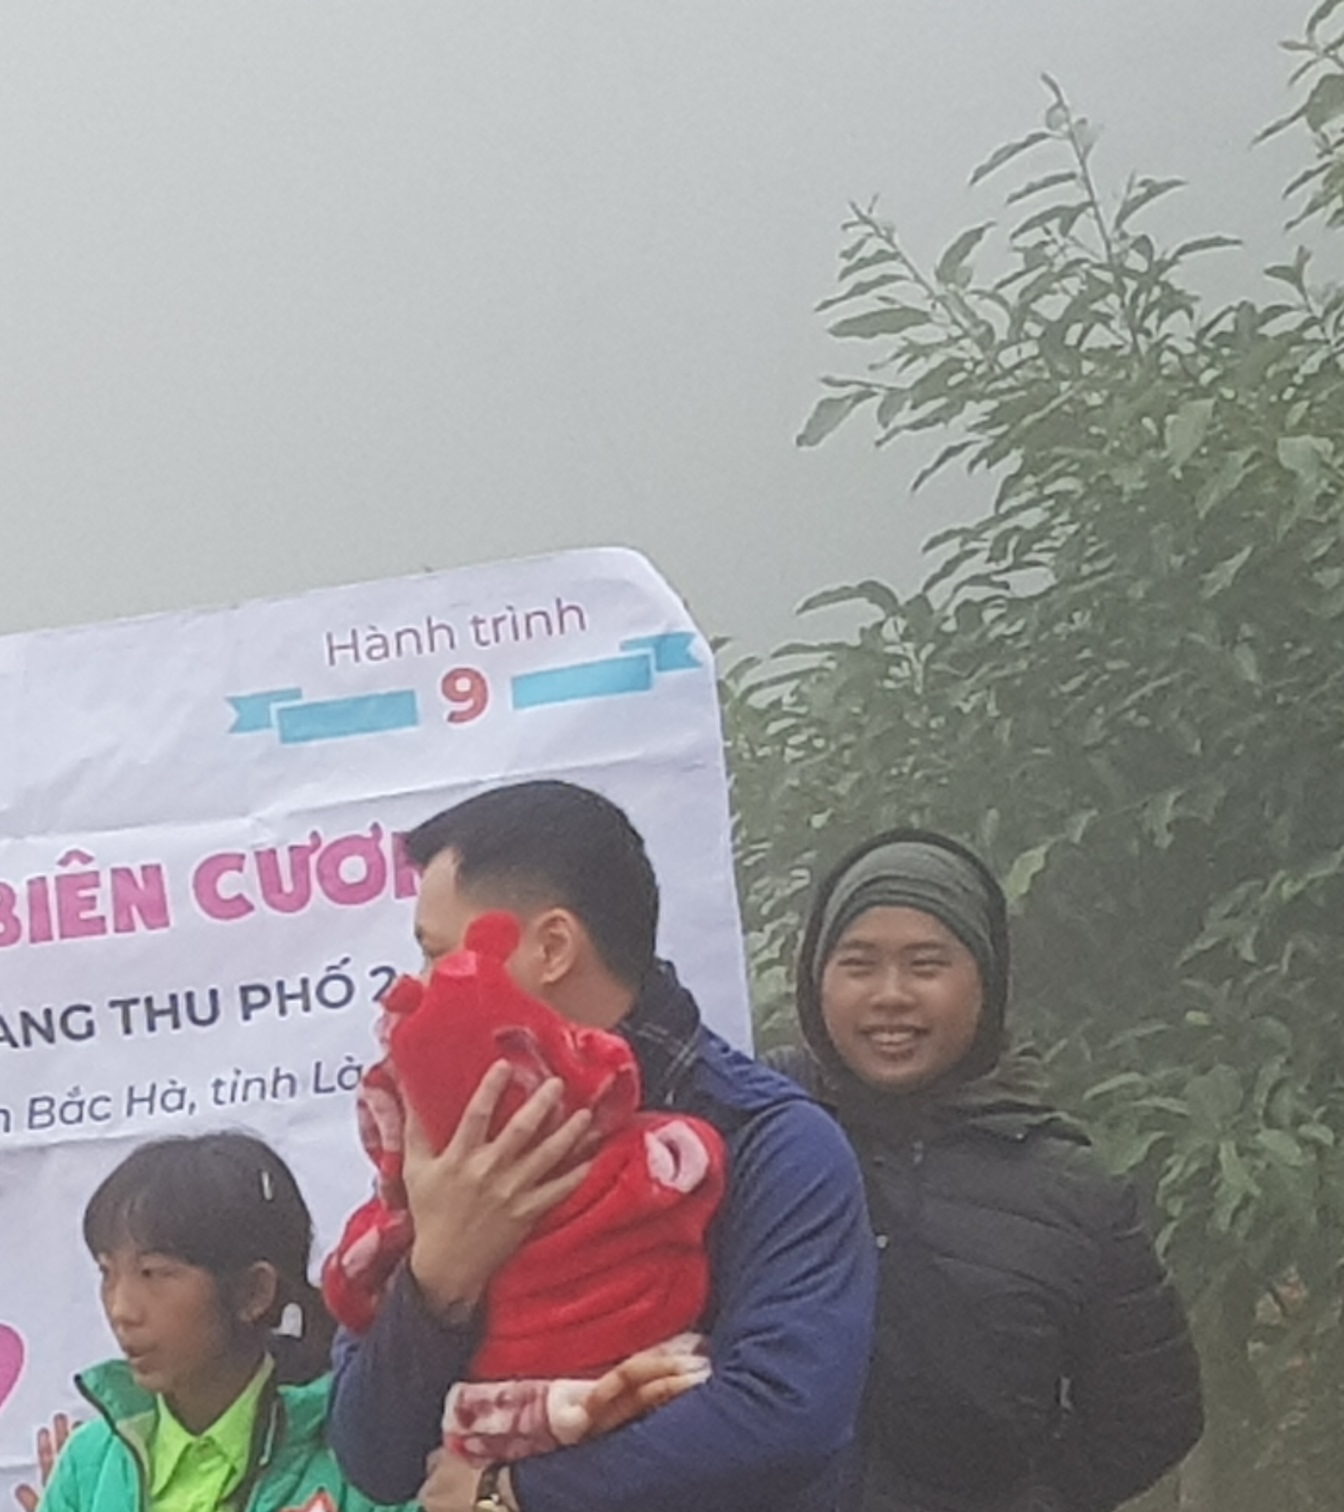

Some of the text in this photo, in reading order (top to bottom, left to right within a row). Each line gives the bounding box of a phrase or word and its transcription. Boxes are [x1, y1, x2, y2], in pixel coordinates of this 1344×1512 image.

[325, 597, 587, 667] Hành trình
[440, 666, 489, 724] 9
[108, 987, 221, 1037] THU
[238, 956, 356, 1022] PHỐ
[27, 1085, 113, 1131] Bắc
[125, 1078, 197, 1118] Hà,
[211, 1066, 298, 1107] tỉnh
[313, 1055, 364, 1095] Là
